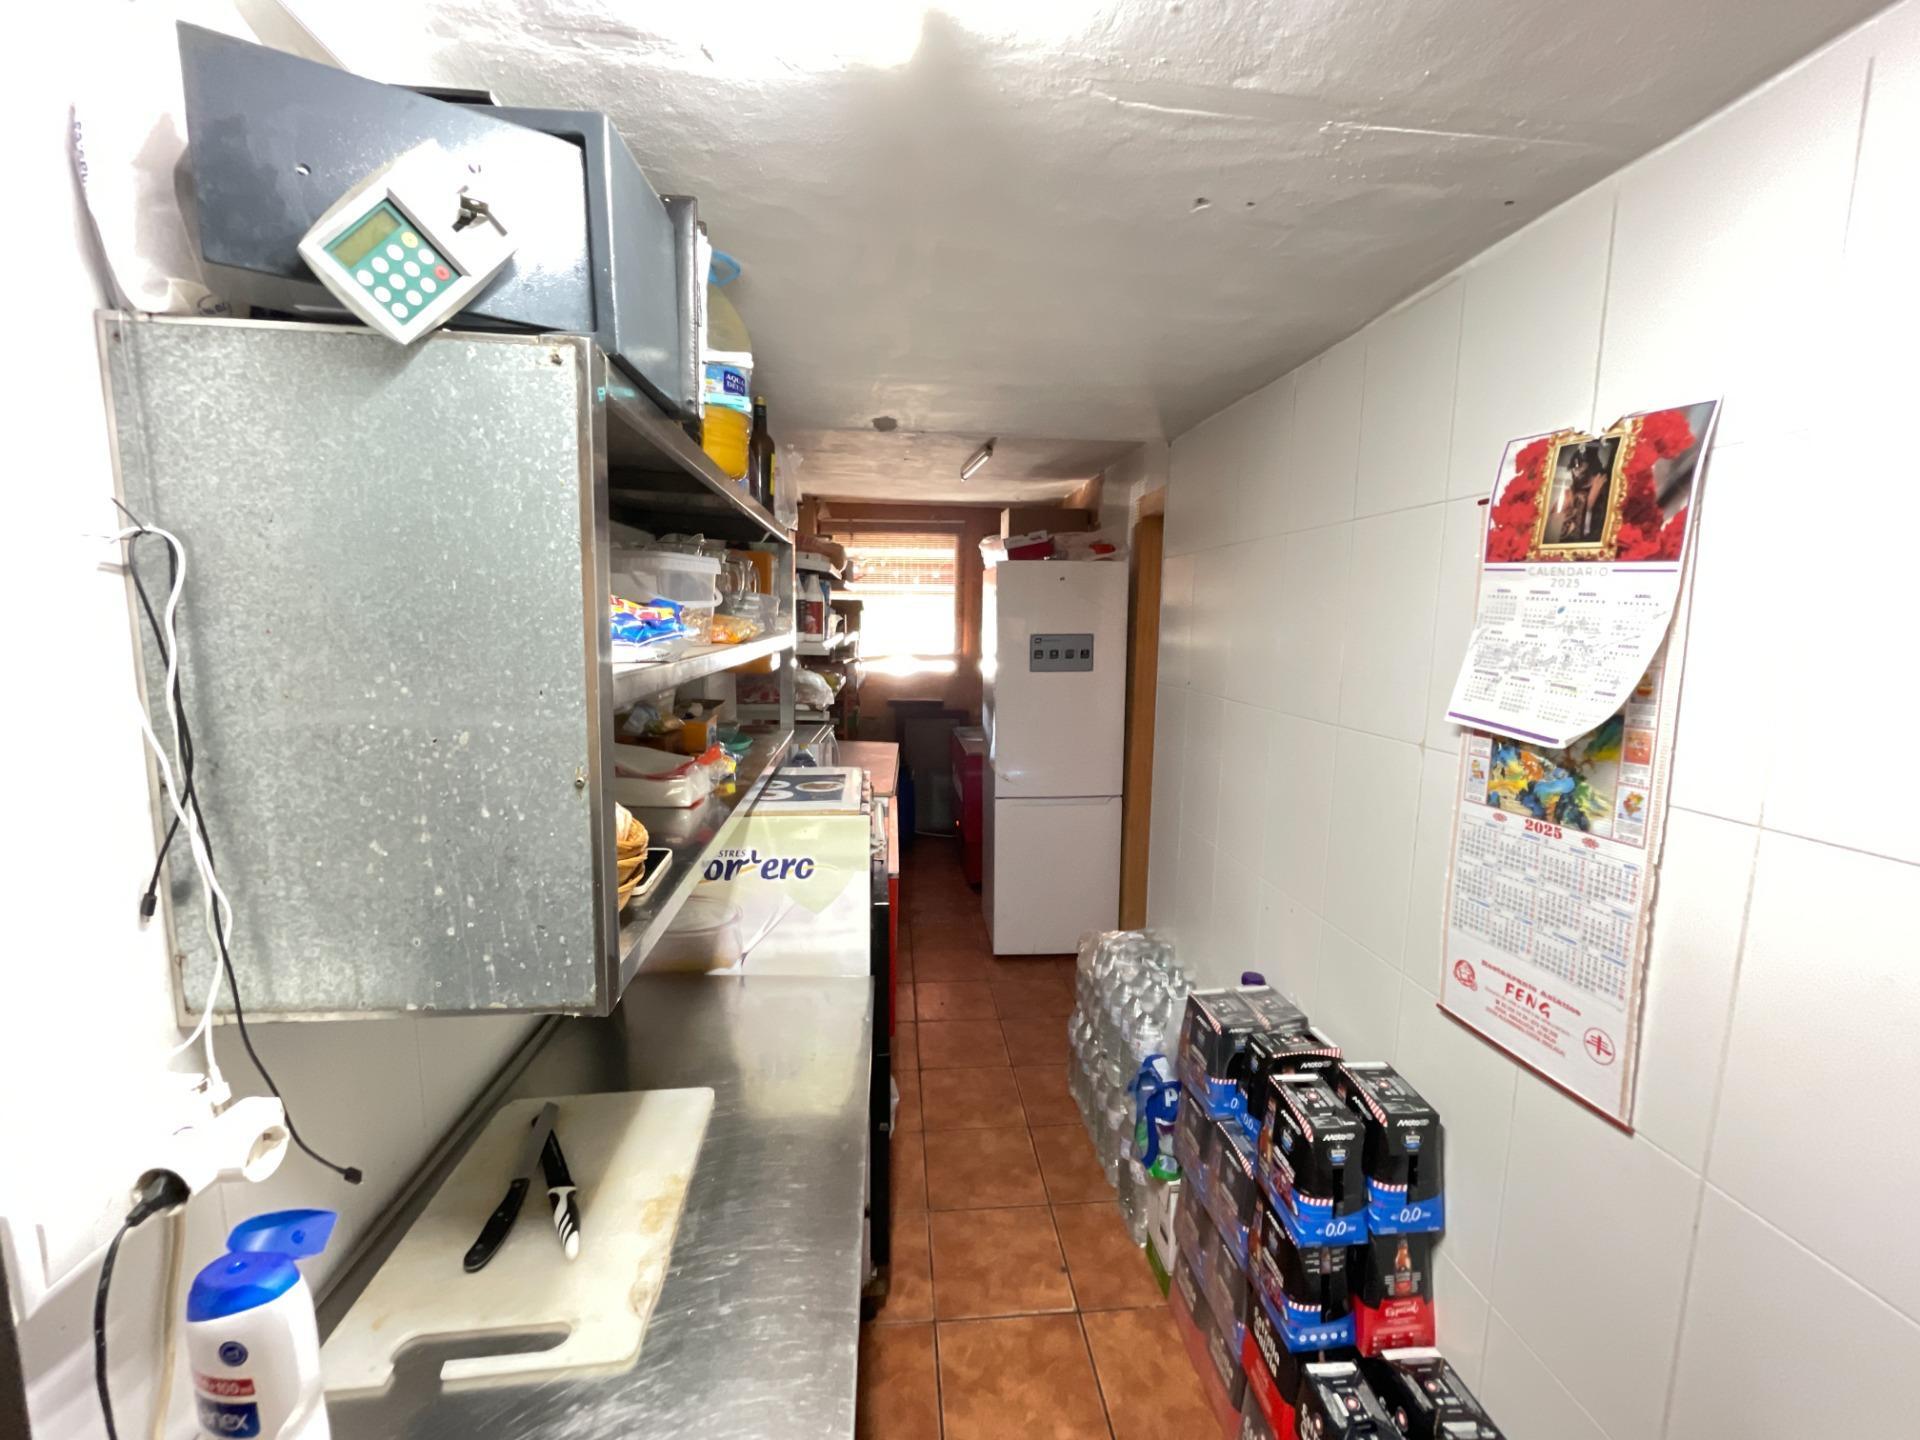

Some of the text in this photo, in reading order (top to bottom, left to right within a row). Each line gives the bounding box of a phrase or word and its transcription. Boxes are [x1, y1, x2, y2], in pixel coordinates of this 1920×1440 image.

[1527, 566, 1609, 578] CALENDARIO
[1550, 578, 1581, 588] 2025
[1524, 818, 1564, 840] 2025
[1504, 982, 1553, 1019] FENG
